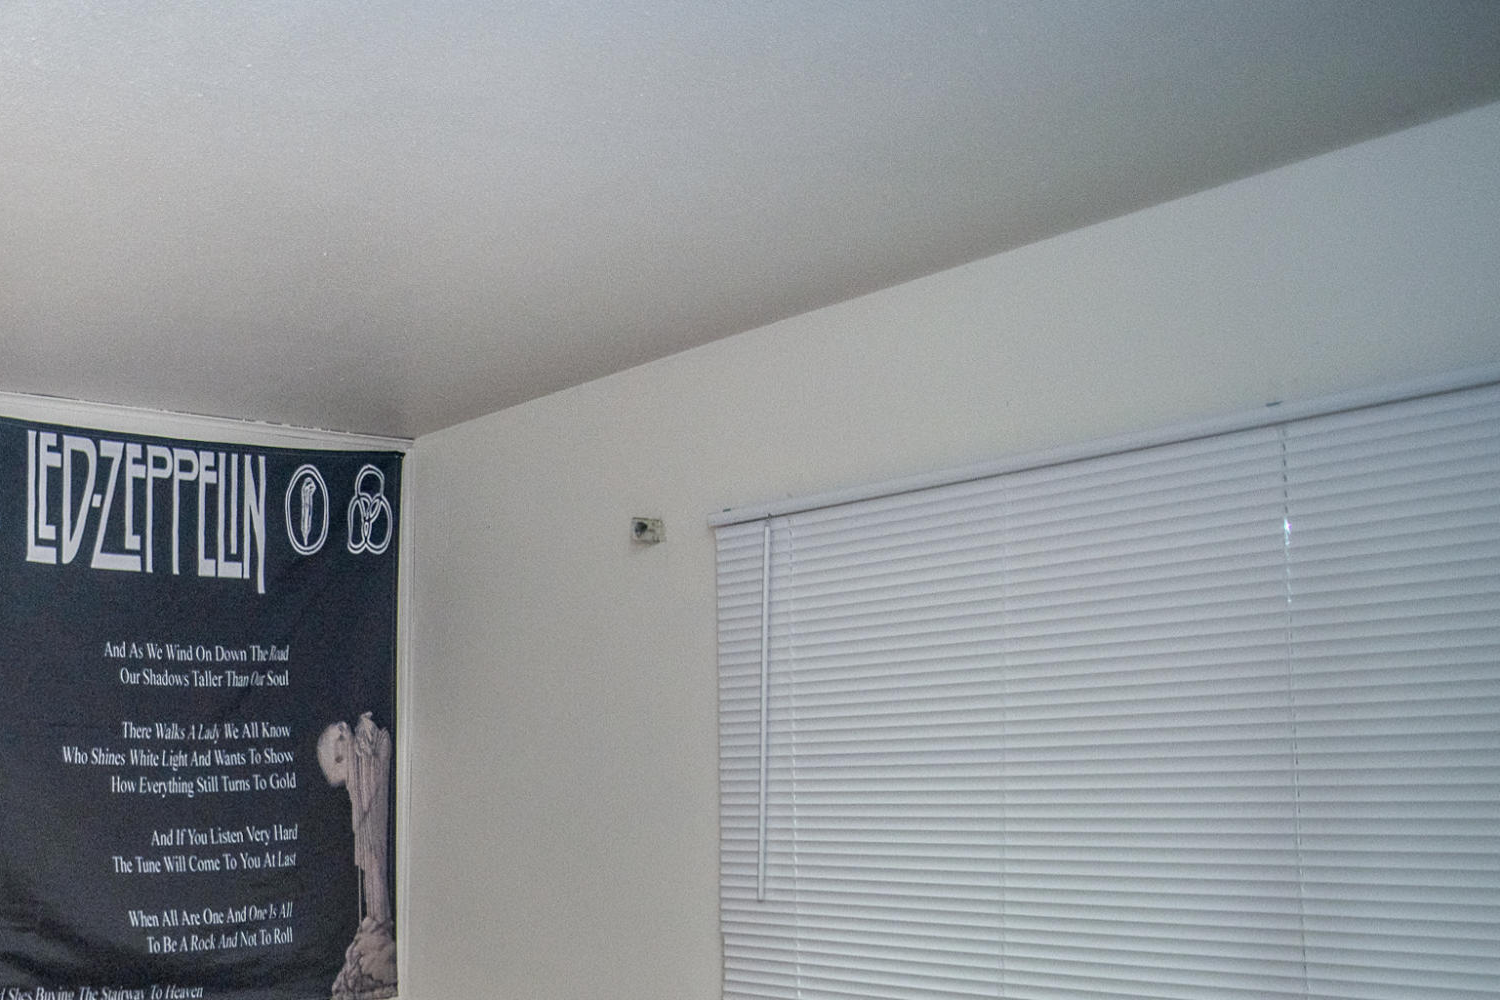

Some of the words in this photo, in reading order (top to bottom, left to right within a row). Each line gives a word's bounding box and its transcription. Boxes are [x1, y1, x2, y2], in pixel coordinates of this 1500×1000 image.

[104, 641, 126, 657] And
[130, 643, 143, 659] As
[147, 644, 162, 659] We
[166, 644, 193, 661] Wind
[196, 646, 212, 661] On
[215, 645, 246, 662] Down
[250, 646, 268, 661] The
[269, 645, 289, 661] Road
[120, 668, 140, 684] Our
[143, 668, 189, 687] Shadows
[192, 670, 222, 687] Taller
[226, 671, 249, 687] Than
[250, 671, 265, 687] Our
[267, 670, 289, 686] Soul
[122, 722, 151, 739] There
[155, 722, 185, 740] Walks
[188, 723, 196, 739] A
[198, 723, 221, 744] Lady
[224, 723, 238, 739] We
[242, 722, 259, 738] All
[262, 722, 291, 738] Know
[63, 746, 88, 765] Who
[91, 747, 125, 765] Shines
[130, 748, 159, 766] White
[162, 750, 187, 771] Light
[191, 750, 211, 766] And
[214, 750, 245, 765] Wants
[249, 749, 261, 764] To
[264, 747, 294, 764] Show
[111, 777, 136, 793] How
[139, 777, 194, 798] Everything
[197, 776, 218, 792] Still
[223, 776, 250, 792] Turns
[252, 774, 266, 791] To
[270, 773, 296, 789] Gold
[151, 830, 173, 846] And
[176, 829, 187, 845] If
[188, 828, 207, 845] You
[210, 827, 243, 843] Listen
[246, 826, 271, 845] Very
[274, 824, 297, 841] Hard
[113, 856, 132, 873] The
[135, 856, 161, 872] Tune
[164, 856, 186, 871] Will
[189, 855, 219, 871] Come
[222, 854, 237, 870] To
[240, 853, 261, 869] You
[264, 852, 276, 867] At
[278, 851, 296, 866] Last
[129, 909, 159, 927] When
[162, 909, 178, 926] All
[182, 909, 200, 925] Are
[203, 907, 224, 924] One
[226, 907, 247, 923] And
[250, 905, 268, 921] One
[269, 904, 277, 919] Is
[279, 902, 292, 918] All
[147, 937, 161, 953] To
[163, 936, 177, 952] Be
[180, 936, 188, 951] A
[191, 935, 216, 950] Rock
[219, 935, 237, 948] And
[240, 932, 257, 948] Not
[260, 931, 272, 945] To
[274, 928, 292, 944] Roll
[150, 984, 163, 1000] To
[165, 985, 203, 999] Heaven
